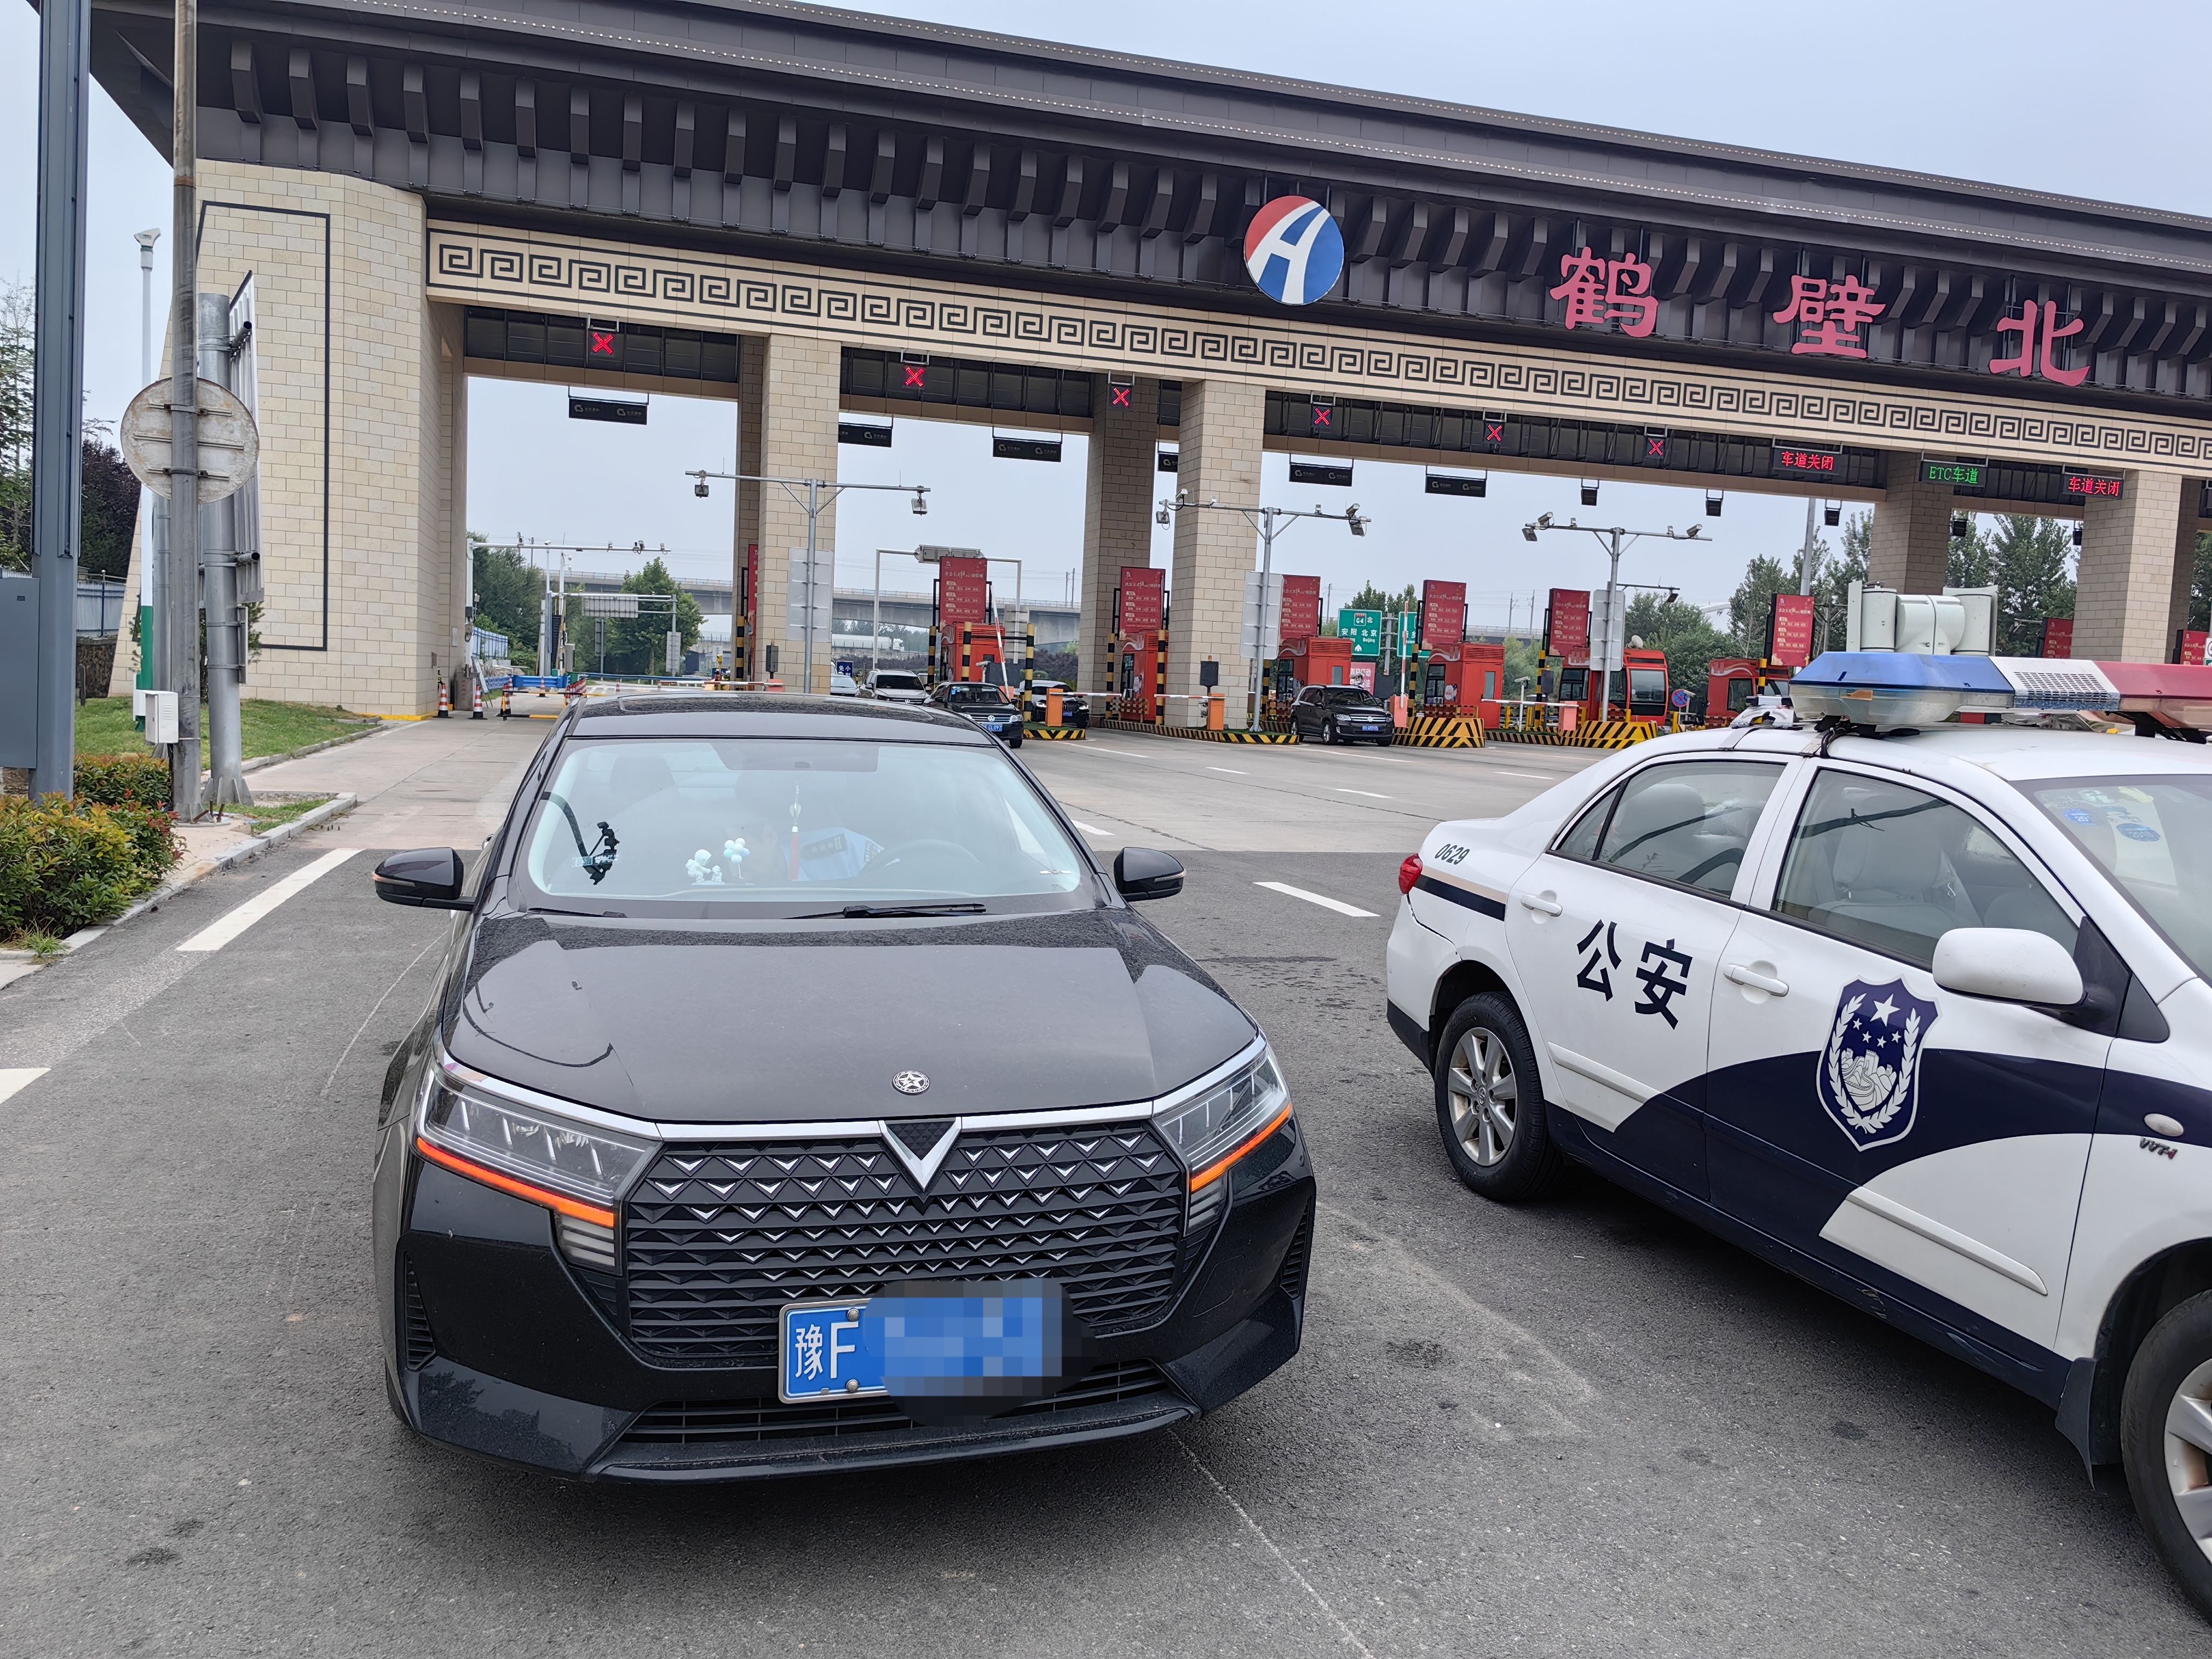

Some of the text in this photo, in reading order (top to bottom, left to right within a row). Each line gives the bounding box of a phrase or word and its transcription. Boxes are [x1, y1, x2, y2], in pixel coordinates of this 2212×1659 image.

[1549, 246, 2090, 387] 鹤壁北
[1782, 451, 1834, 470] 车道关闭
[1929, 467, 1978, 483] ETC车道
[2068, 476, 2120, 496] 车道关闭
[1434, 844, 1470, 865] 0629
[1576, 919, 1692, 1030] 公安
